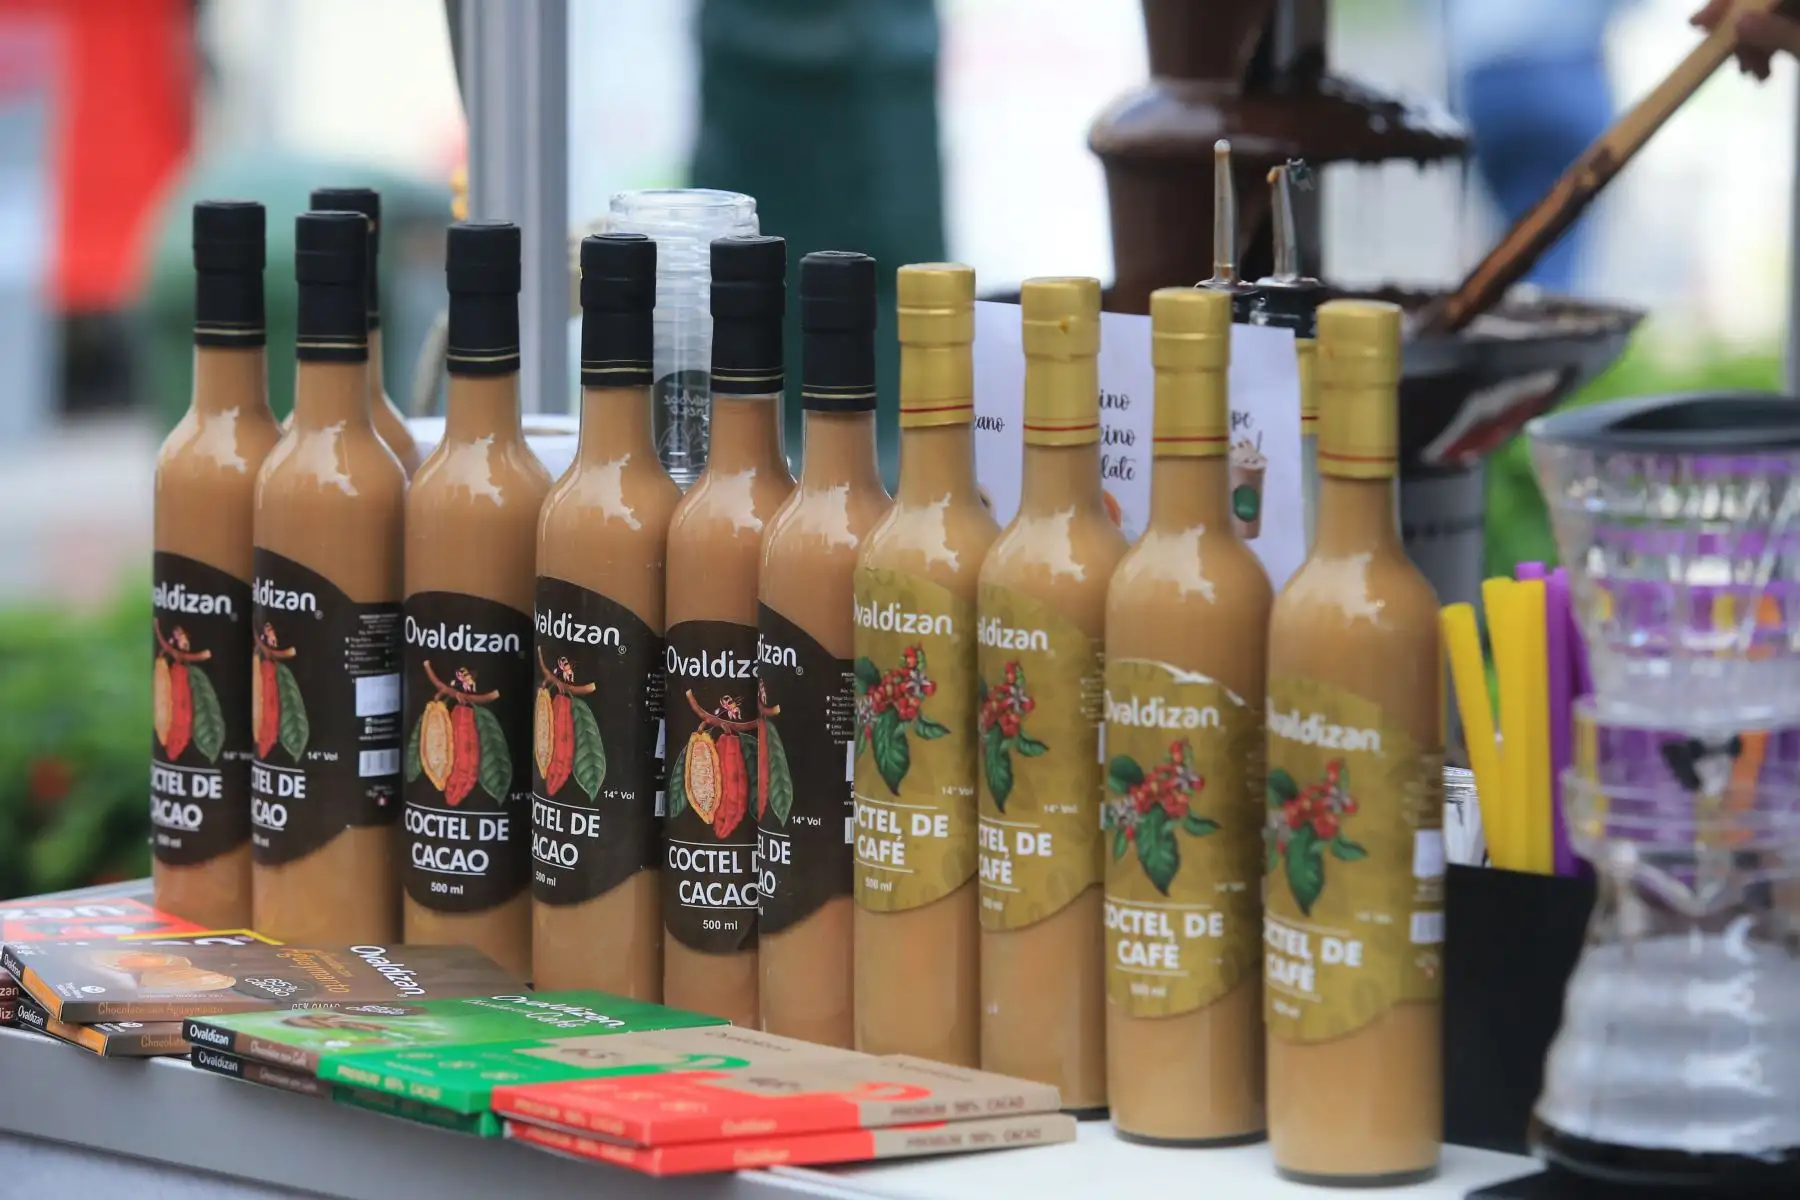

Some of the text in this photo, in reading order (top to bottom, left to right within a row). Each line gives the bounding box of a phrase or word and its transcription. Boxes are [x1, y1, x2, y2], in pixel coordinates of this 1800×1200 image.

[405, 615, 520, 653] Ovaldizan
[533, 607, 620, 647] valdizan
[666, 645, 759, 679] Ovaldiza
[191, 774, 223, 799] DE
[278, 773, 306, 799] DE
[603, 790, 635, 800] 14° Vol
[404, 807, 510, 841] COCTEL DE
[570, 812, 601, 838] DE
[806, 816, 821, 826] Vol
[911, 813, 949, 838] DE
[411, 841, 489, 873] CACAO
[531, 830, 579, 867] ACAO
[769, 838, 791, 865] DE
[857, 834, 905, 866] CAFÉ
[1016, 831, 1053, 857] DE
[668, 845, 743, 874] COCTEL
[430, 881, 464, 895] 500 ml
[679, 879, 759, 906] CACAO
[702, 919, 738, 930] 500 ml
[1184, 911, 1224, 938] DE
[1321, 936, 1363, 968] DE
[350, 945, 426, 996] Ovaldizan
[17, 1005, 44, 1027] Ovaldizan
[189, 1023, 229, 1046] Ovaldizan
[198, 1050, 238, 1073] Ovaldizan
